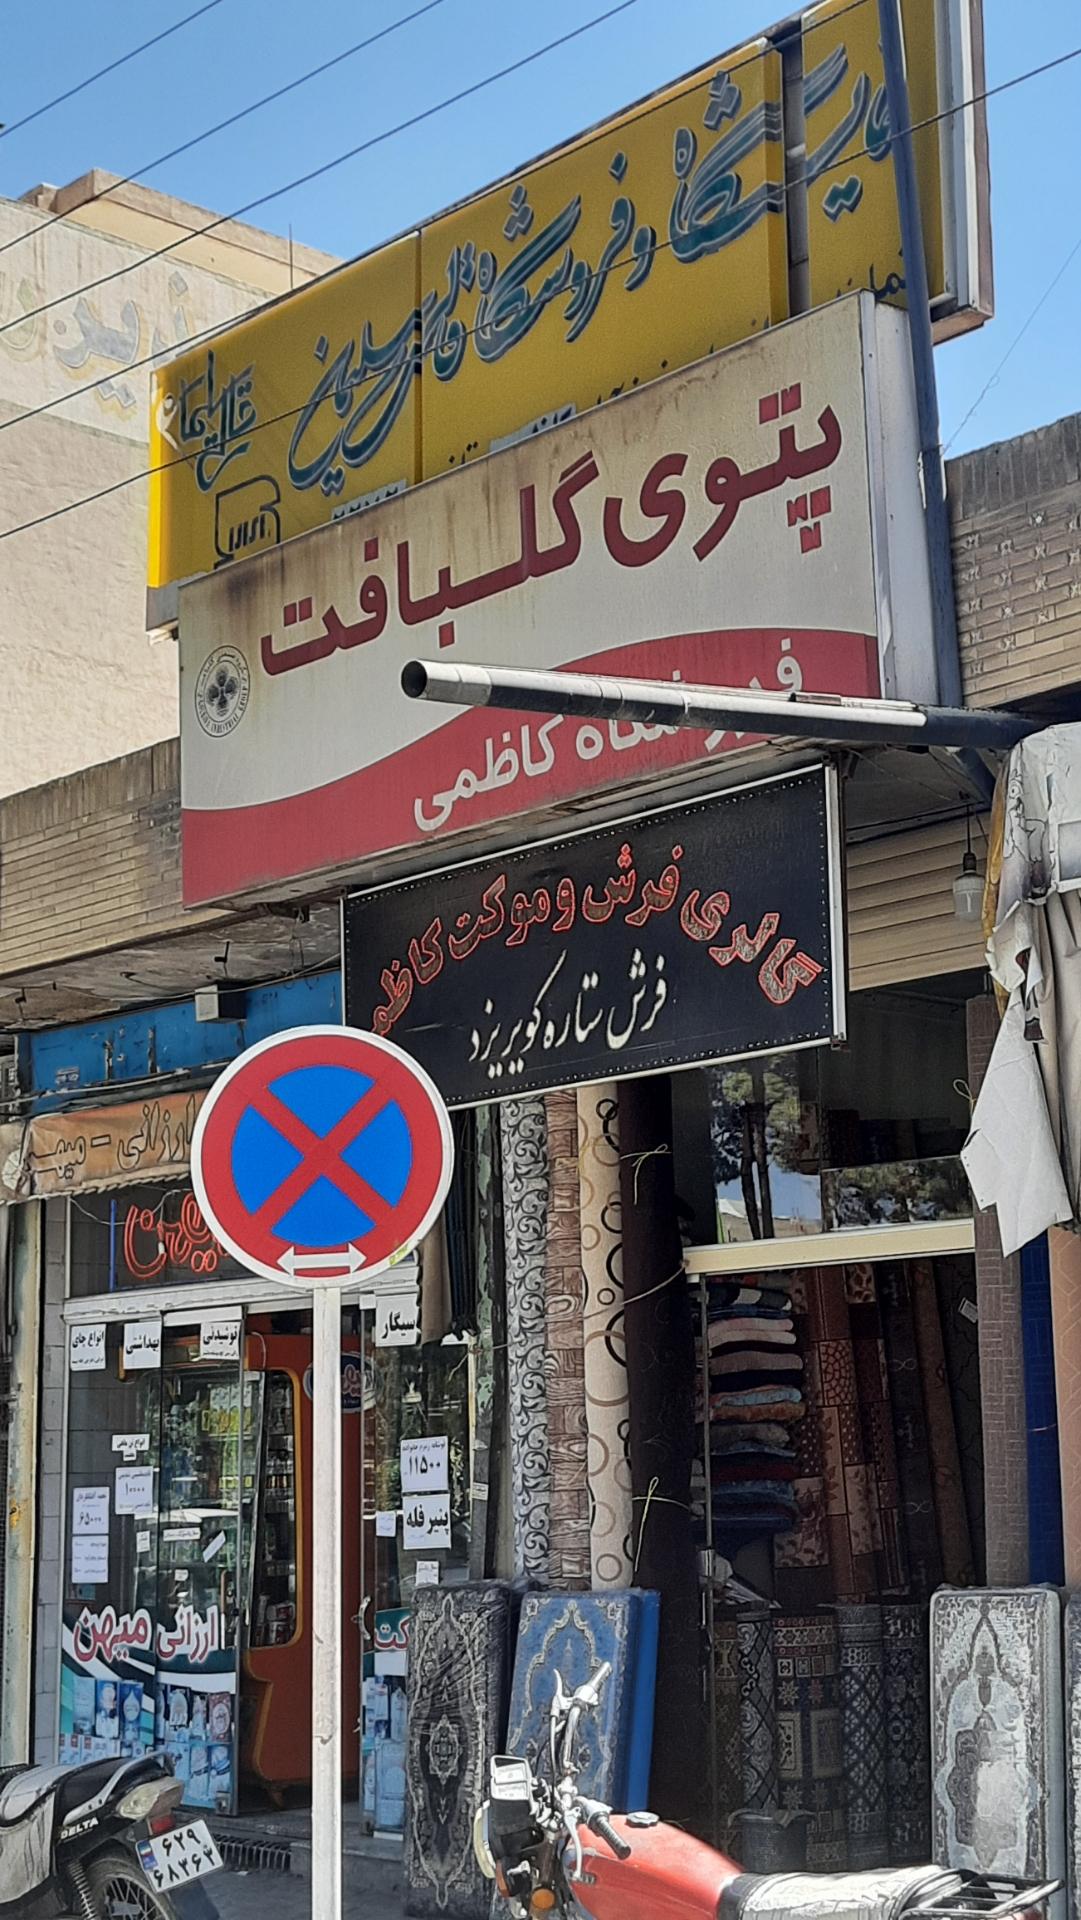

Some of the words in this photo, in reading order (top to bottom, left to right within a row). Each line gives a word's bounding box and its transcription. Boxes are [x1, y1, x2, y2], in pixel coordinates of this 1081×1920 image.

[474, 150, 634, 364] فروشگاه
[624, 224, 657, 292] و
[603, 383, 842, 568] پتوی
[261, 451, 600, 676] گلبافت
[414, 714, 565, 832] کاظمی
[553, 877, 576, 931] و
[581, 843, 684, 927] فرش
[448, 874, 551, 960] موکت
[371, 917, 444, 1037] کاظم
[606, 948, 668, 1050] فرش
[501, 949, 567, 1075] کویر
[543, 971, 603, 1050] ستاره
[468, 998, 503, 1079] یزد
[29, 1135, 87, 1179] میه
[117, 1093, 196, 1170] ارزانی
[72, 1332, 86, 1348] چای
[88, 1330, 104, 1347] انواع
[126, 1334, 160, 1355] بهداشتی
[203, 1325, 238, 1345] نوشیدنی
[381, 1312, 416, 1339] سیگار
[409, 1455, 441, 1475] ۱۱۵۰۰
[407, 1504, 424, 1528] فله
[427, 1508, 449, 1535] پنیر
[73, 1608, 150, 1662] میهن
[157, 1607, 216, 1661] ارزانی
[60, 1817, 99, 1839] DELTA
[162, 1828, 201, 1857] ۶۲۹
[154, 1847, 215, 1888] ۶۸۳۶۳
